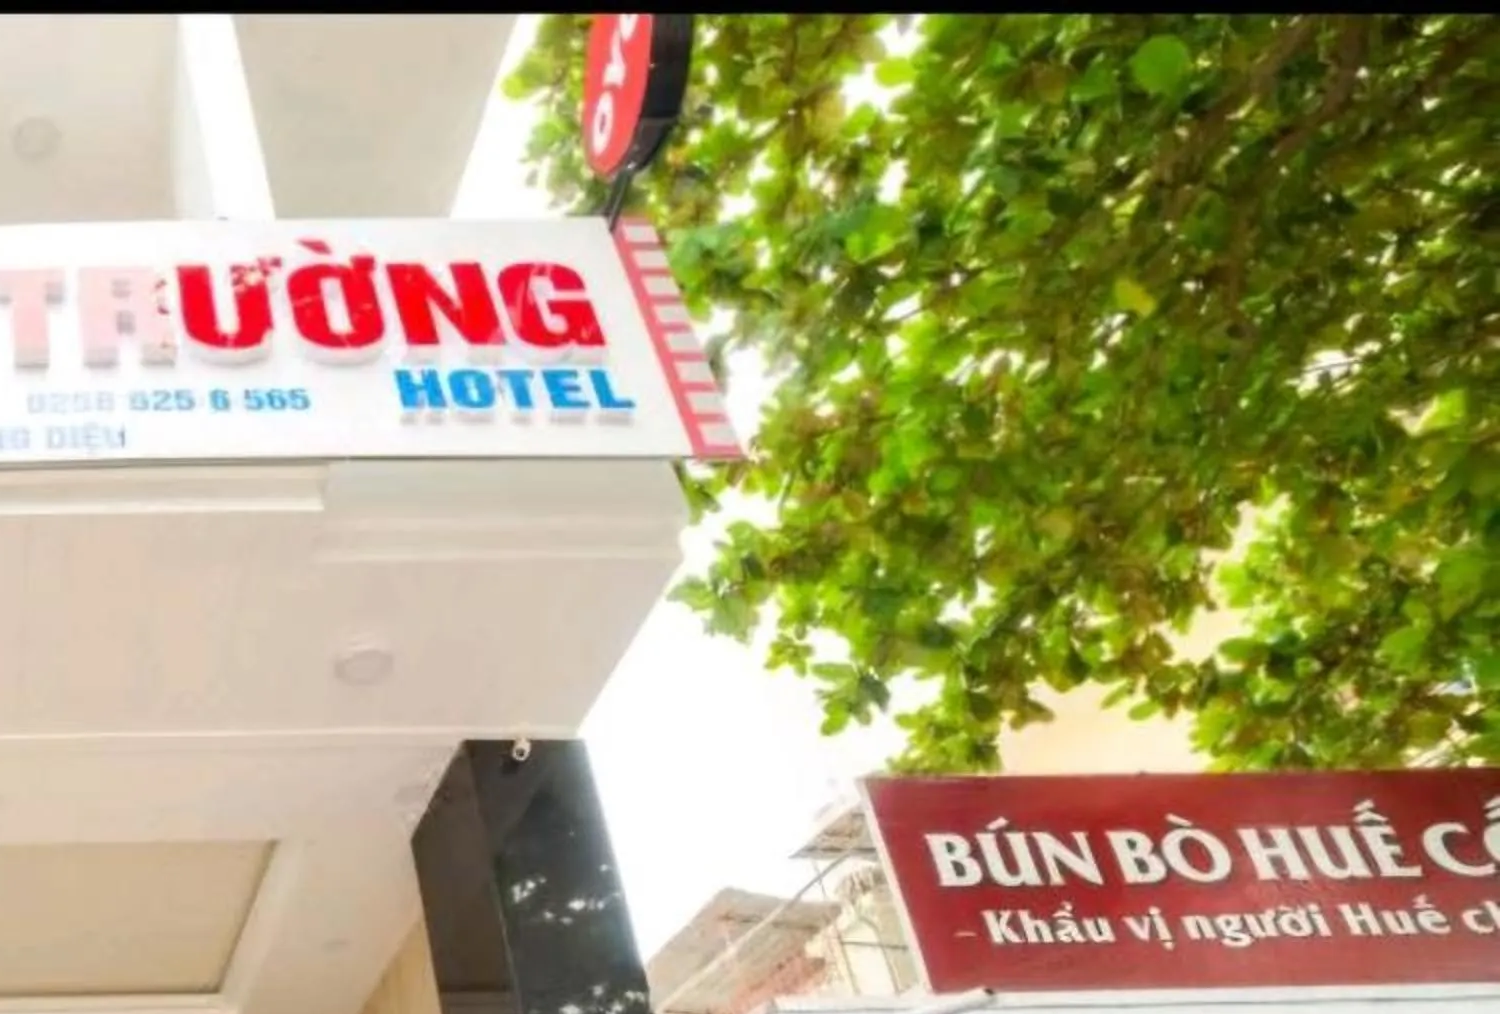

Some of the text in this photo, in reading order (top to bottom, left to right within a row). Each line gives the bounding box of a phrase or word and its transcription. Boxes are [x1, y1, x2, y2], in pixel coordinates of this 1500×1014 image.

[210, 387, 231, 412] 6
[244, 386, 312, 412] 565
[395, 368, 636, 422] HOTEL
[925, 816, 1104, 887] BÚN
[1106, 813, 1232, 886] BÒ
[1239, 799, 1422, 882] HUẾ
[980, 901, 1116, 944] Khẩu
[1121, 906, 1176, 950] vị
[1183, 903, 1333, 948] người
[1344, 894, 1451, 938] Huế
